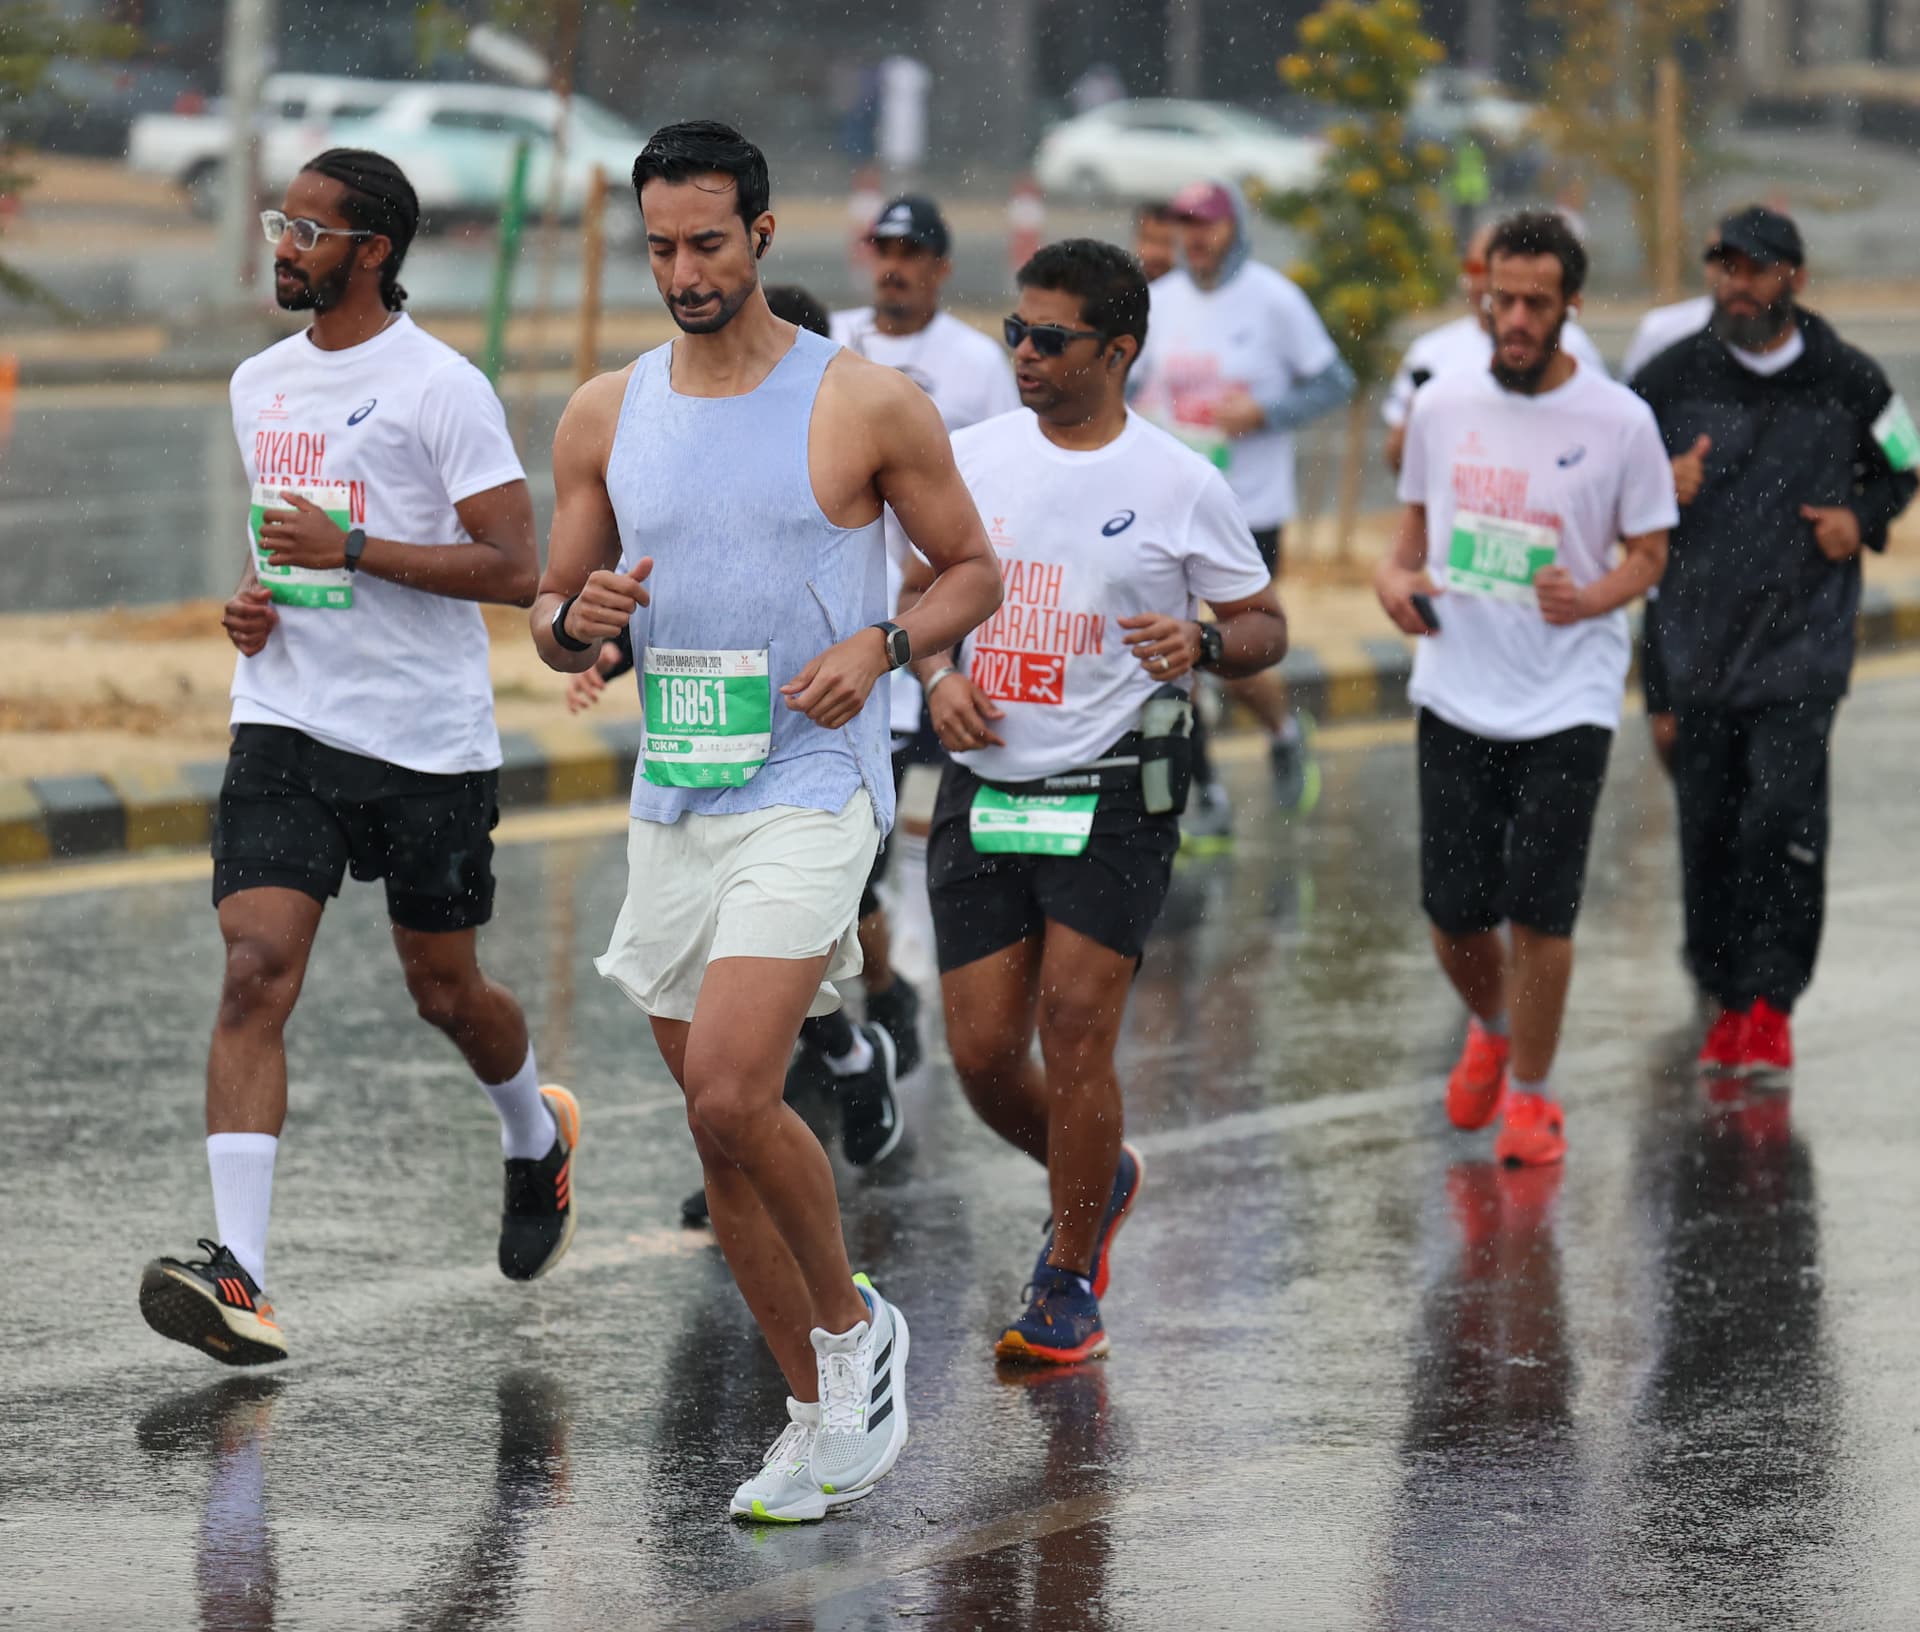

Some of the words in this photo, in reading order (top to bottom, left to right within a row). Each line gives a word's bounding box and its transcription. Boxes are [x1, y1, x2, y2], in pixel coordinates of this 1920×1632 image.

[254, 431, 326, 477] RIYADH
[999, 559, 1063, 608] YADH
[656, 654, 675, 667] RIYADH
[675, 655, 708, 668] MARATHON
[708, 656, 722, 668] 2024
[974, 650, 1023, 697] 2024
[658, 678, 727, 726] 16851
[651, 741, 679, 752] 10KM
